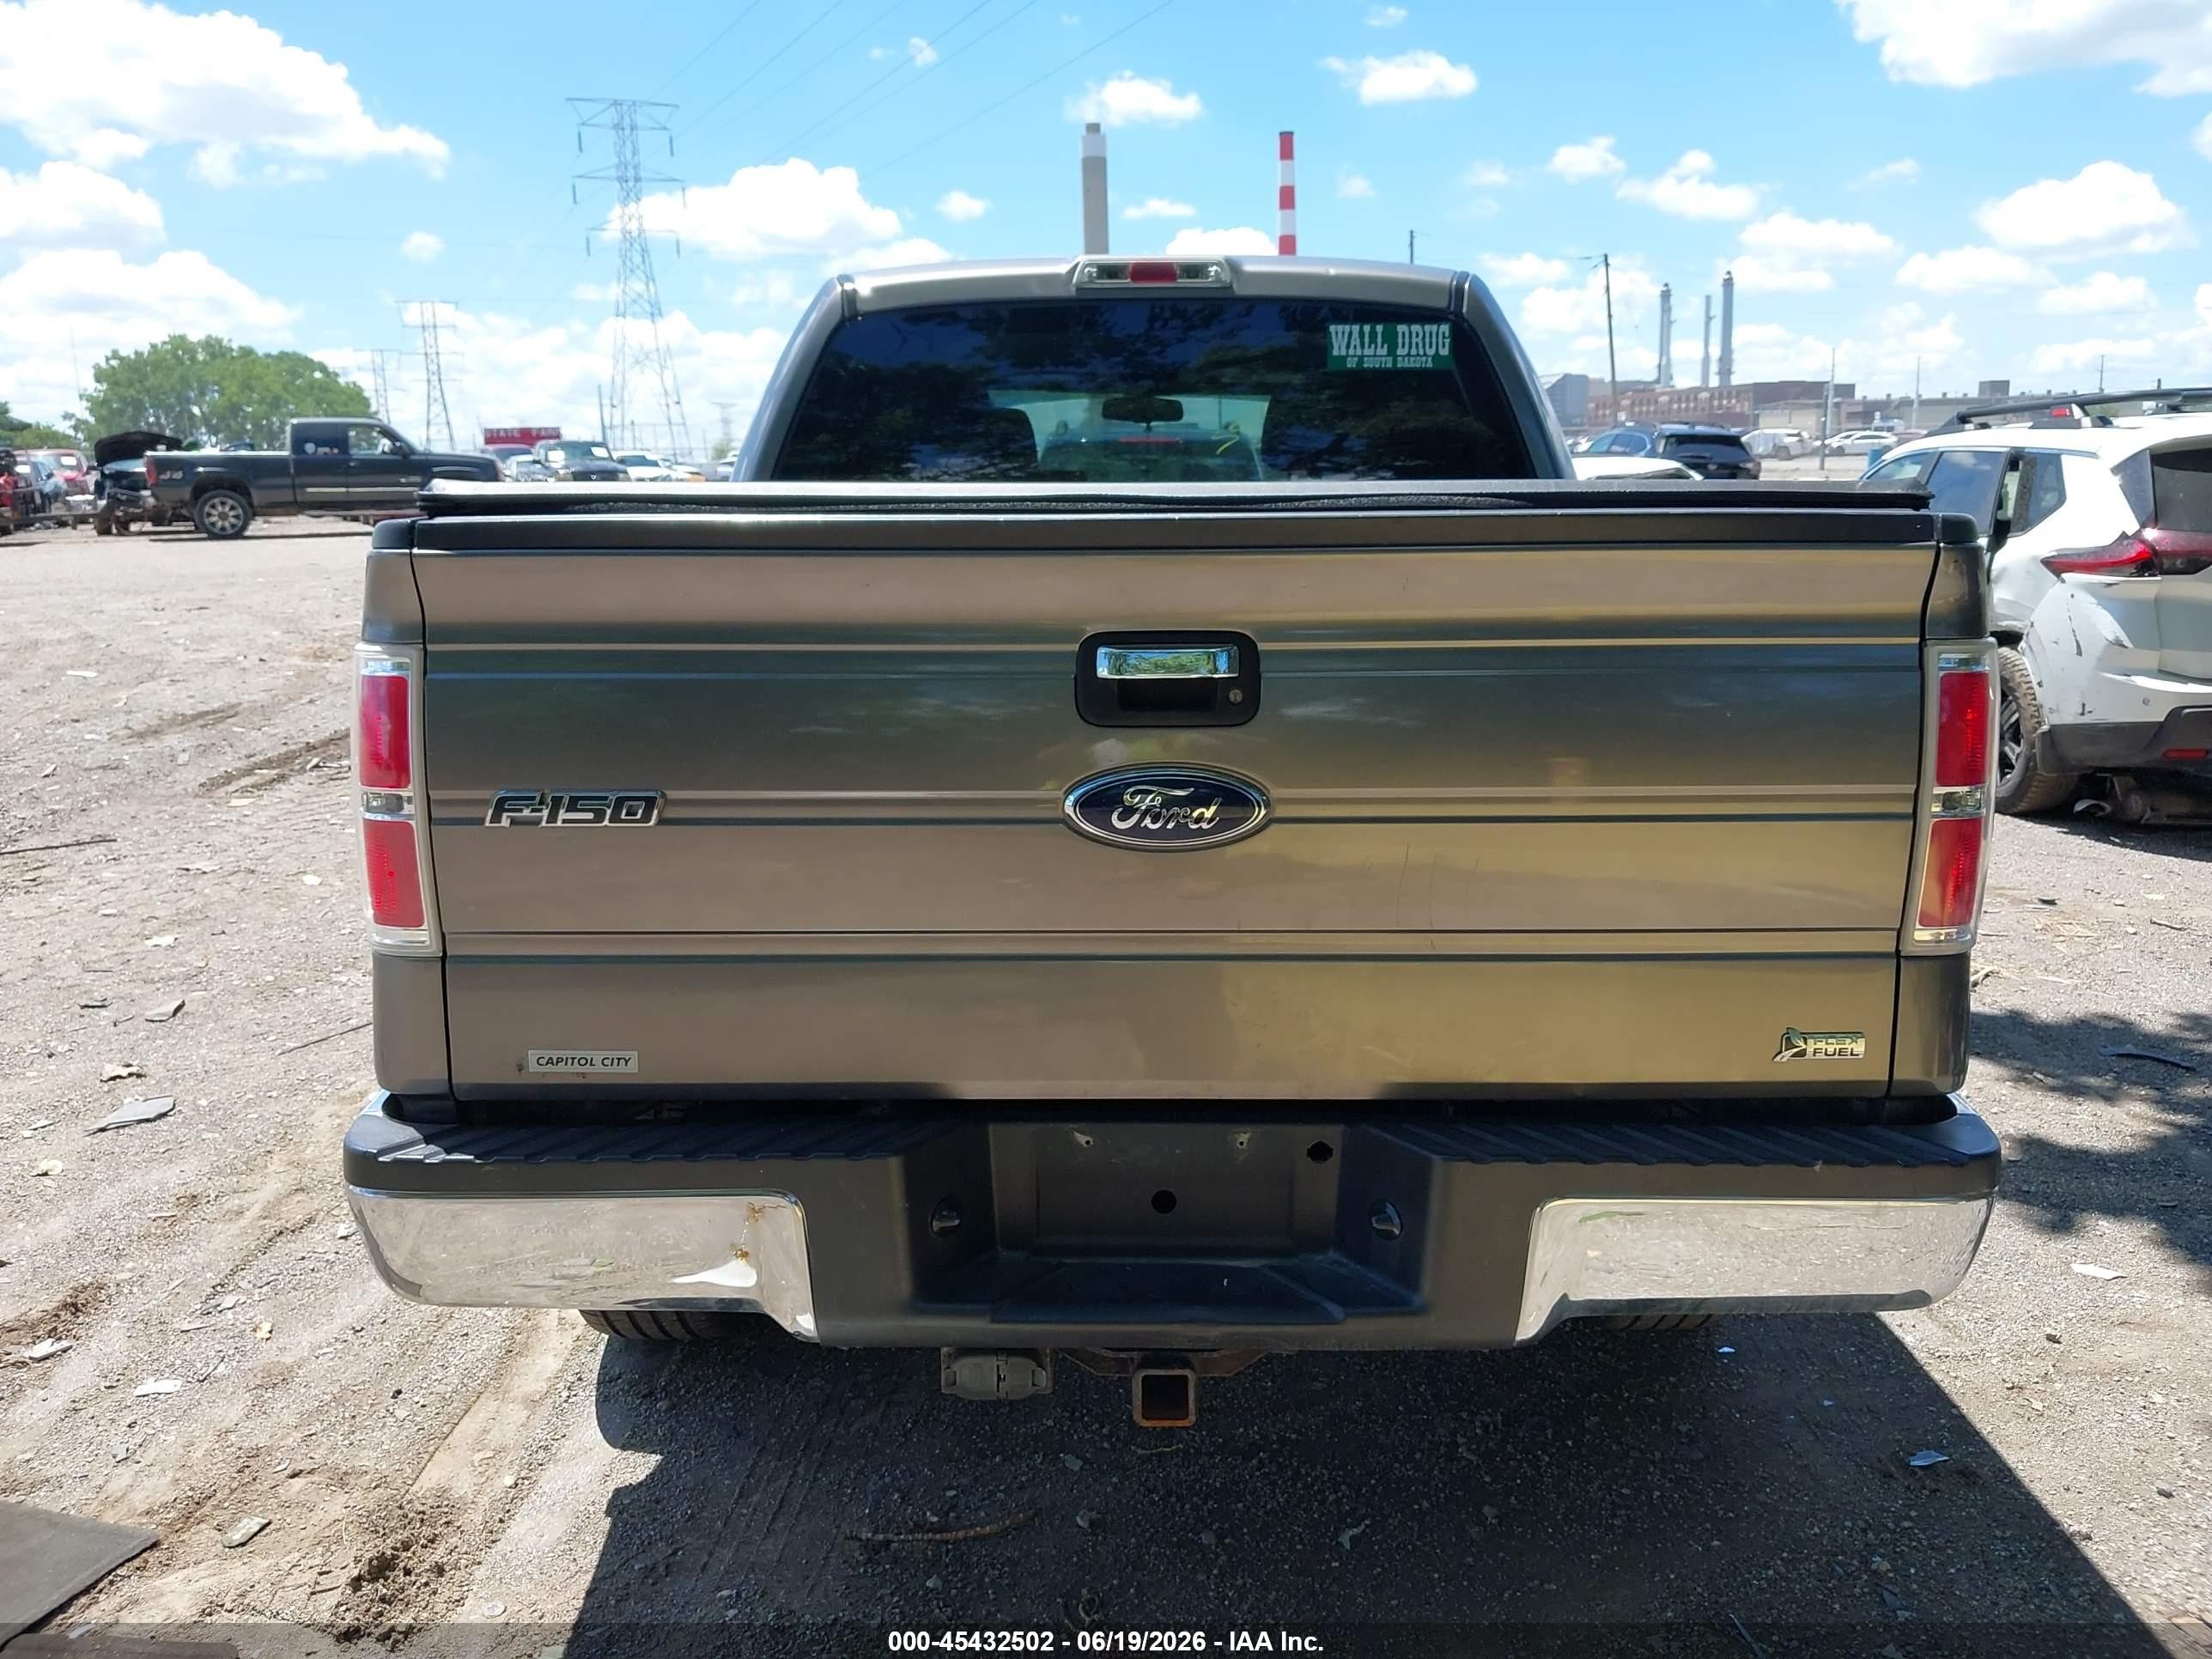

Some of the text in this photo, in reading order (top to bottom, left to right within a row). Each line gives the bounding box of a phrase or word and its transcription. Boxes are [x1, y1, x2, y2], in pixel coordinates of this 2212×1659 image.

[1329, 325, 1450, 356] WALL DRUG
[1346, 356, 1433, 368] OF SOUTH DAKOTA
[484, 789, 667, 828] F-150
[1111, 785, 1223, 830] Ford
[1813, 1036, 1860, 1046] FLEX
[1813, 1048, 1861, 1057] FUEL
[536, 1056, 632, 1066] CAPITOL CITY
